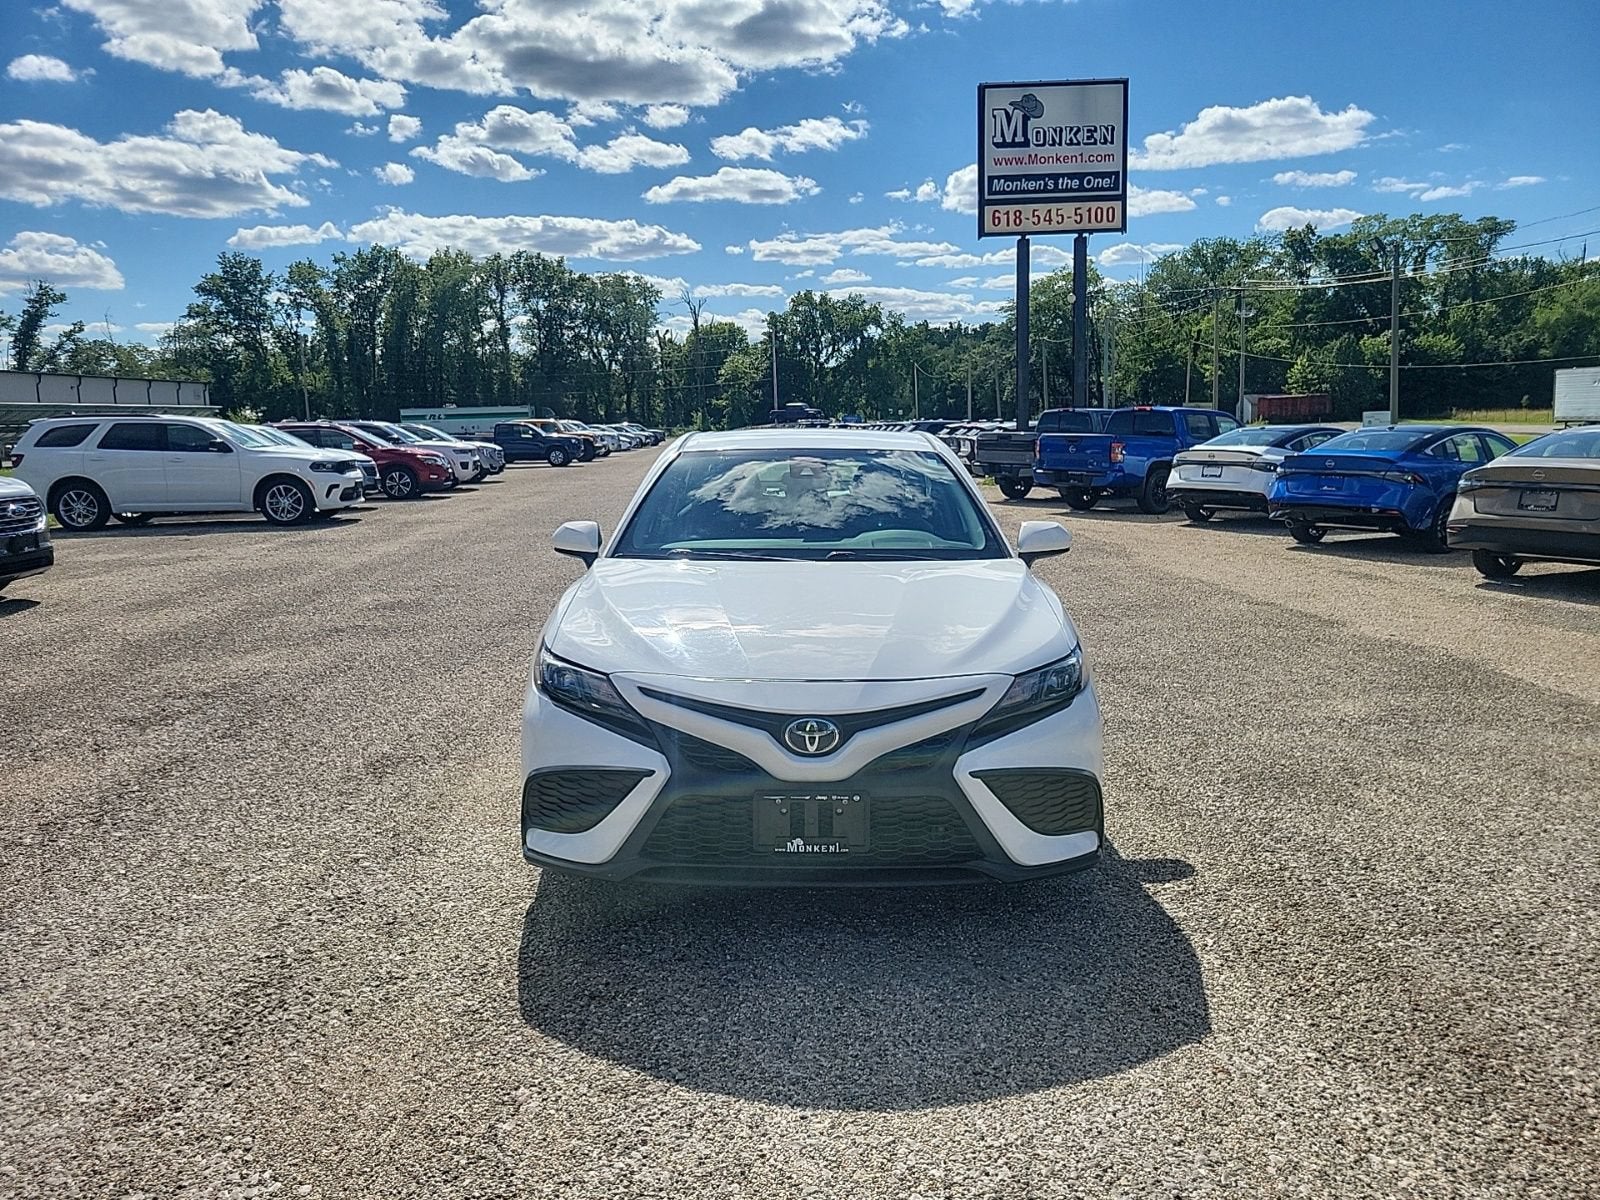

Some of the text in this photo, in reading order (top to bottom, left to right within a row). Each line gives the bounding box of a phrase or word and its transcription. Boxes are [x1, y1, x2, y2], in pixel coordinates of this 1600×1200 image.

[992, 108, 1115, 148] MONKEN
[993, 152, 1115, 166] www.Monken1.com
[992, 175, 1115, 191] Monken's the One!
[991, 206, 1116, 227] 618-545-5100
